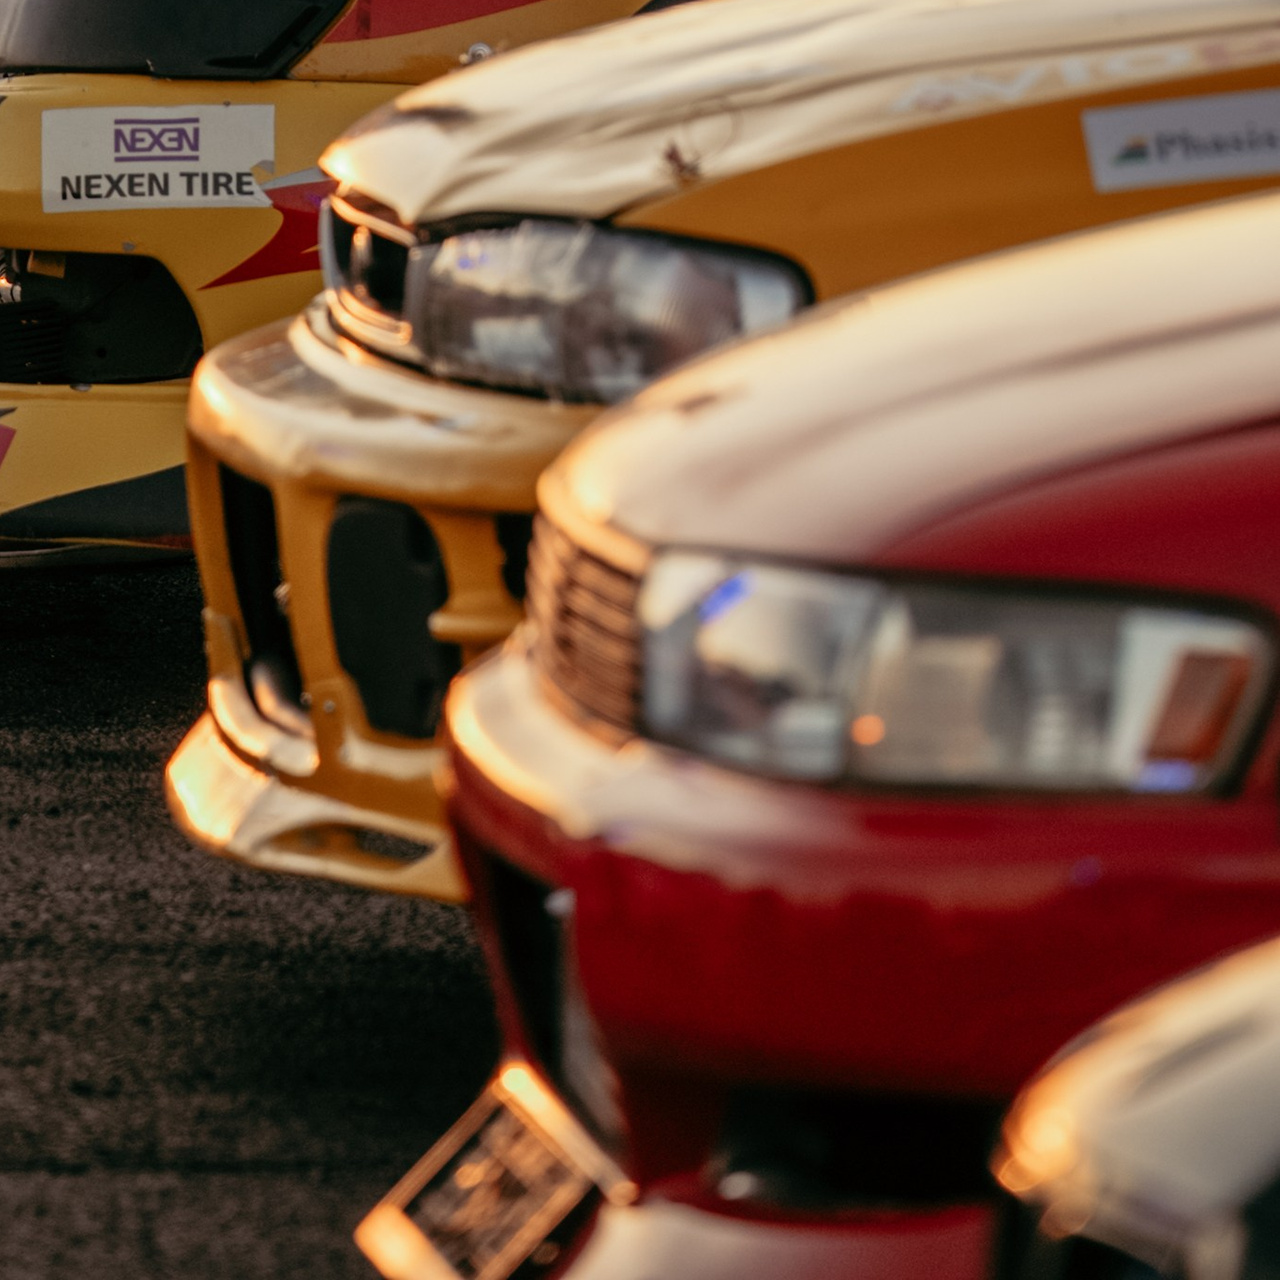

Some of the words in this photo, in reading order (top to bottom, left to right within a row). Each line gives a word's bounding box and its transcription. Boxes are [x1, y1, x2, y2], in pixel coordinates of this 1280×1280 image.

[114, 126, 200, 154] NEXEN
[61, 172, 170, 201] NEXEN
[179, 171, 255, 197] TIRE
